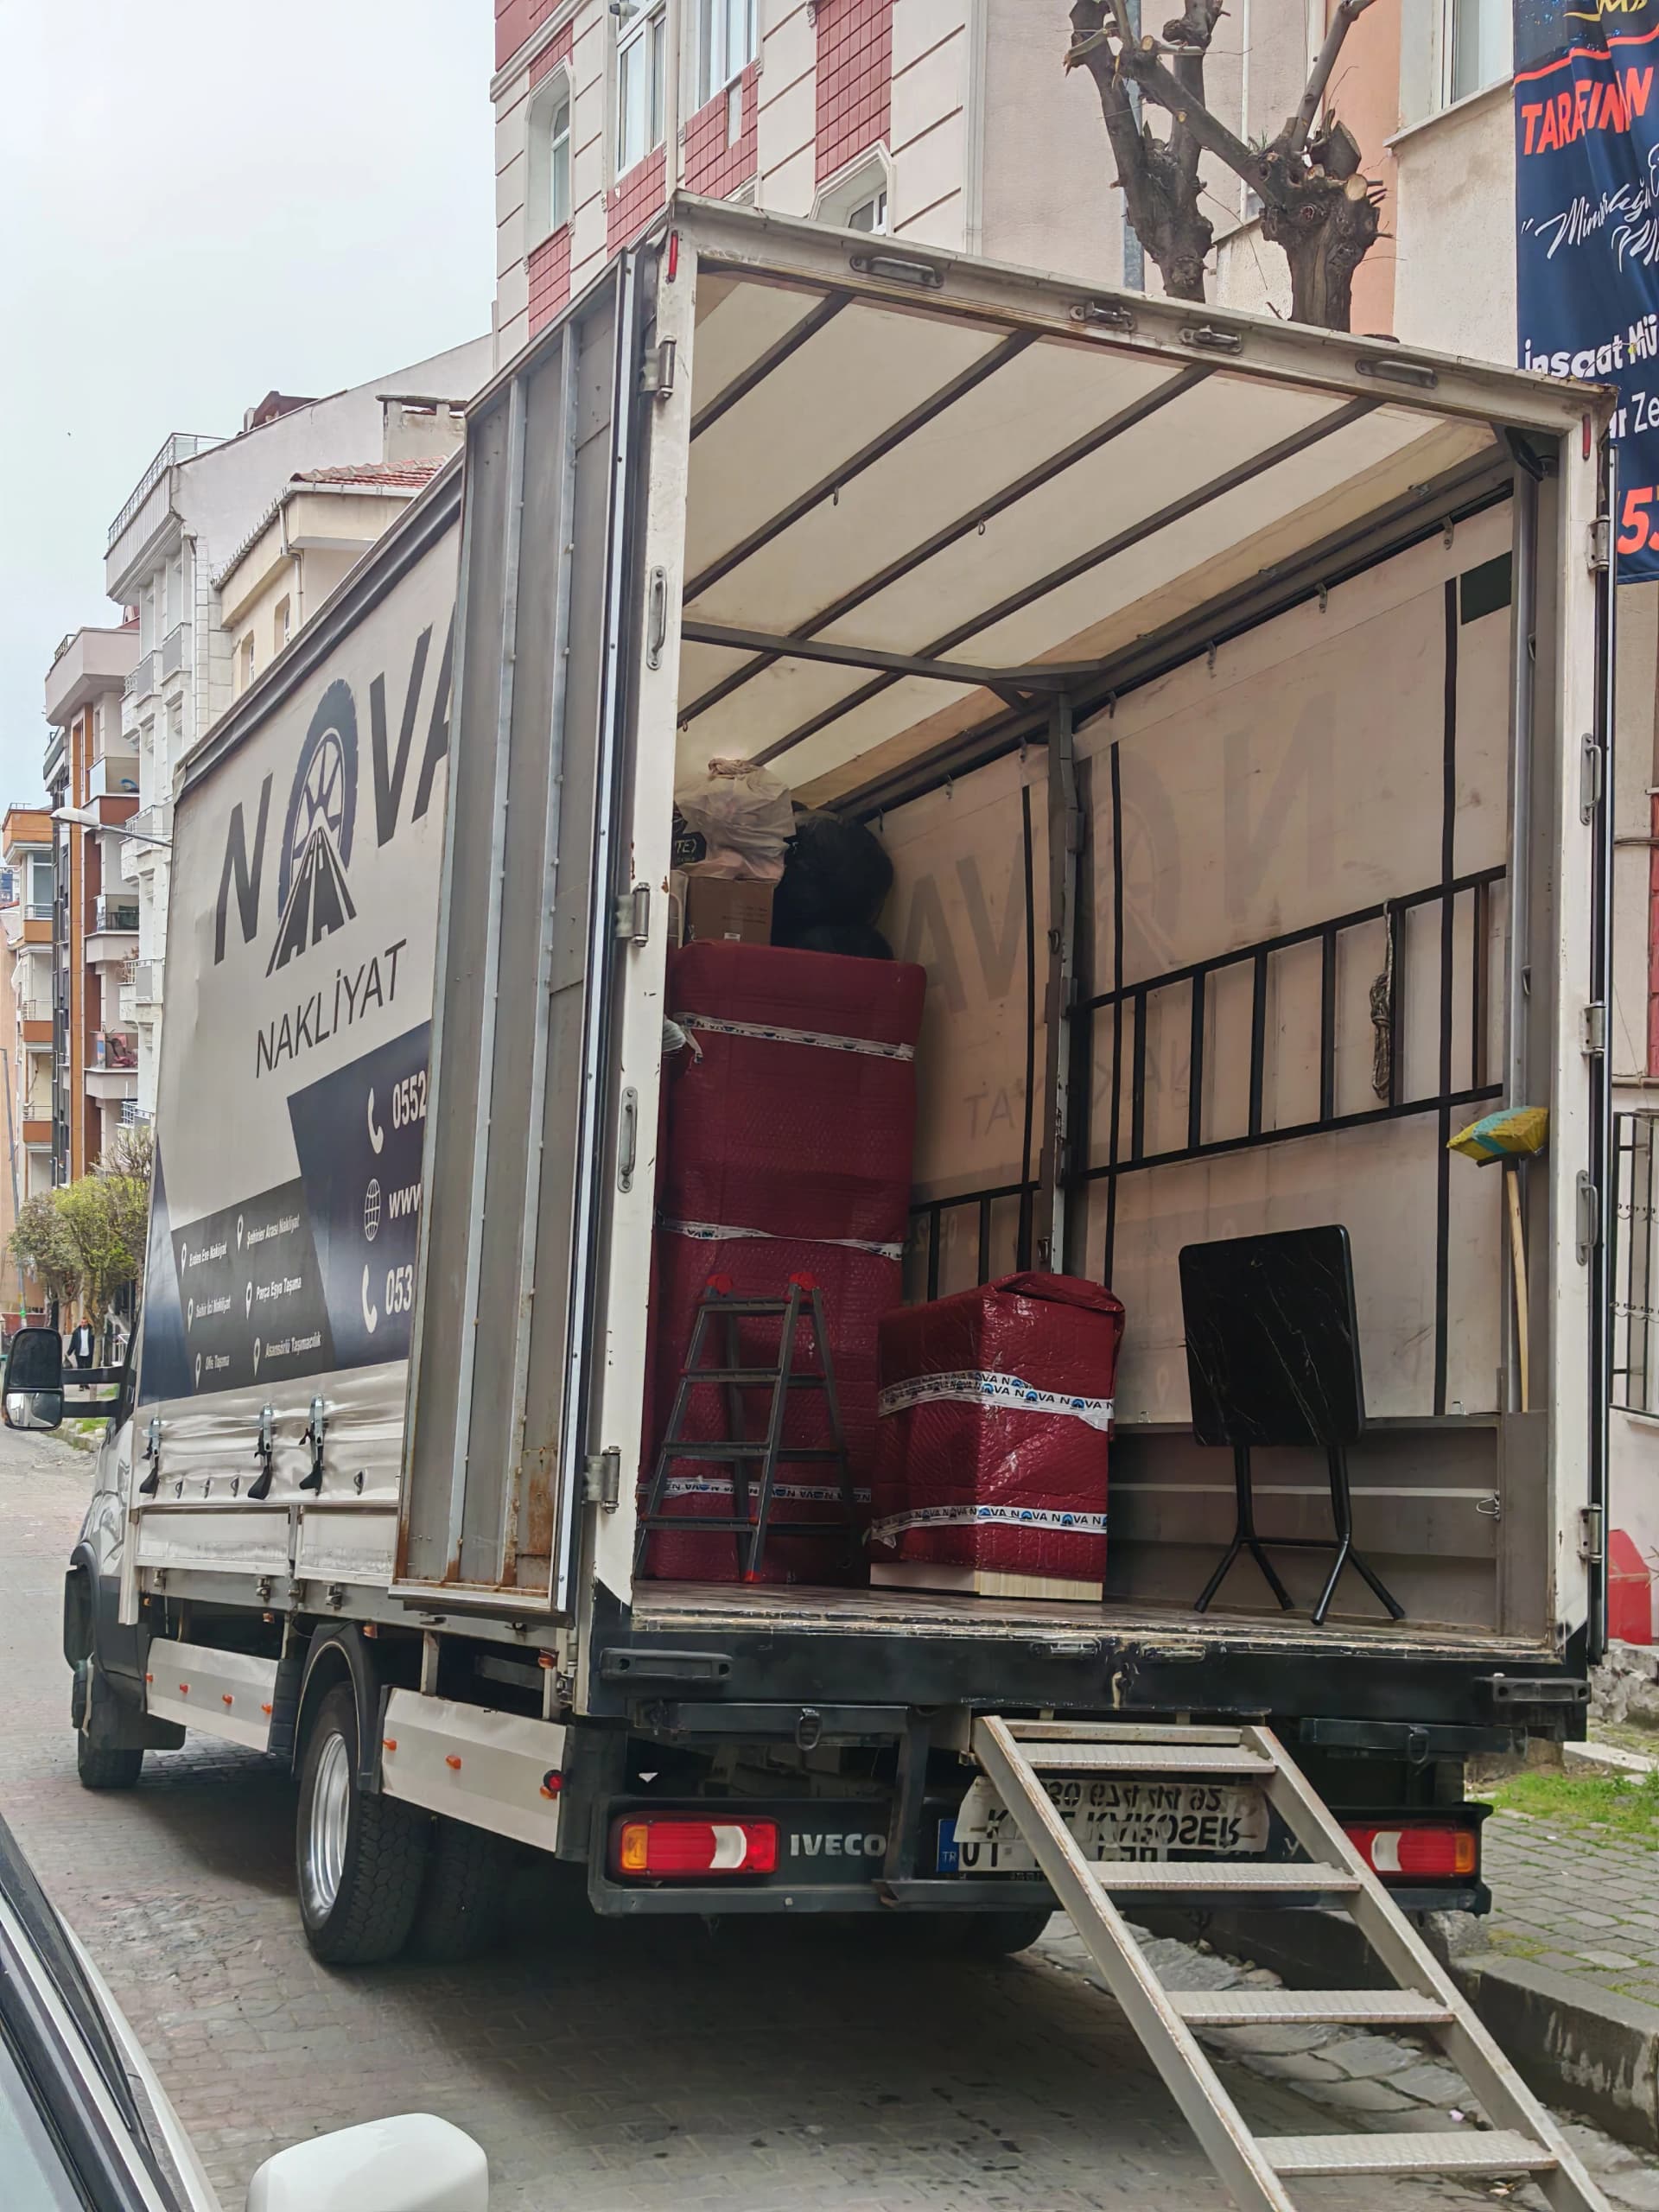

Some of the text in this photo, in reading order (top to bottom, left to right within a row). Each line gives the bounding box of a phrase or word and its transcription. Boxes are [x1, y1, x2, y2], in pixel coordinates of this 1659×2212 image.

[256, 938, 407, 1078] NAKLİYAT
[392, 1070, 426, 1129] 0552
[385, 1264, 413, 1316] 053
[1014, 1389, 1055, 1403] NOVA
[1059, 1395, 1103, 1411] NOVA
[1011, 1510, 1047, 1522] NOVA
[1052, 1514, 1089, 1525] NOVA
[790, 1834, 887, 1856] IVECO
[942, 1852, 957, 1862] TR
